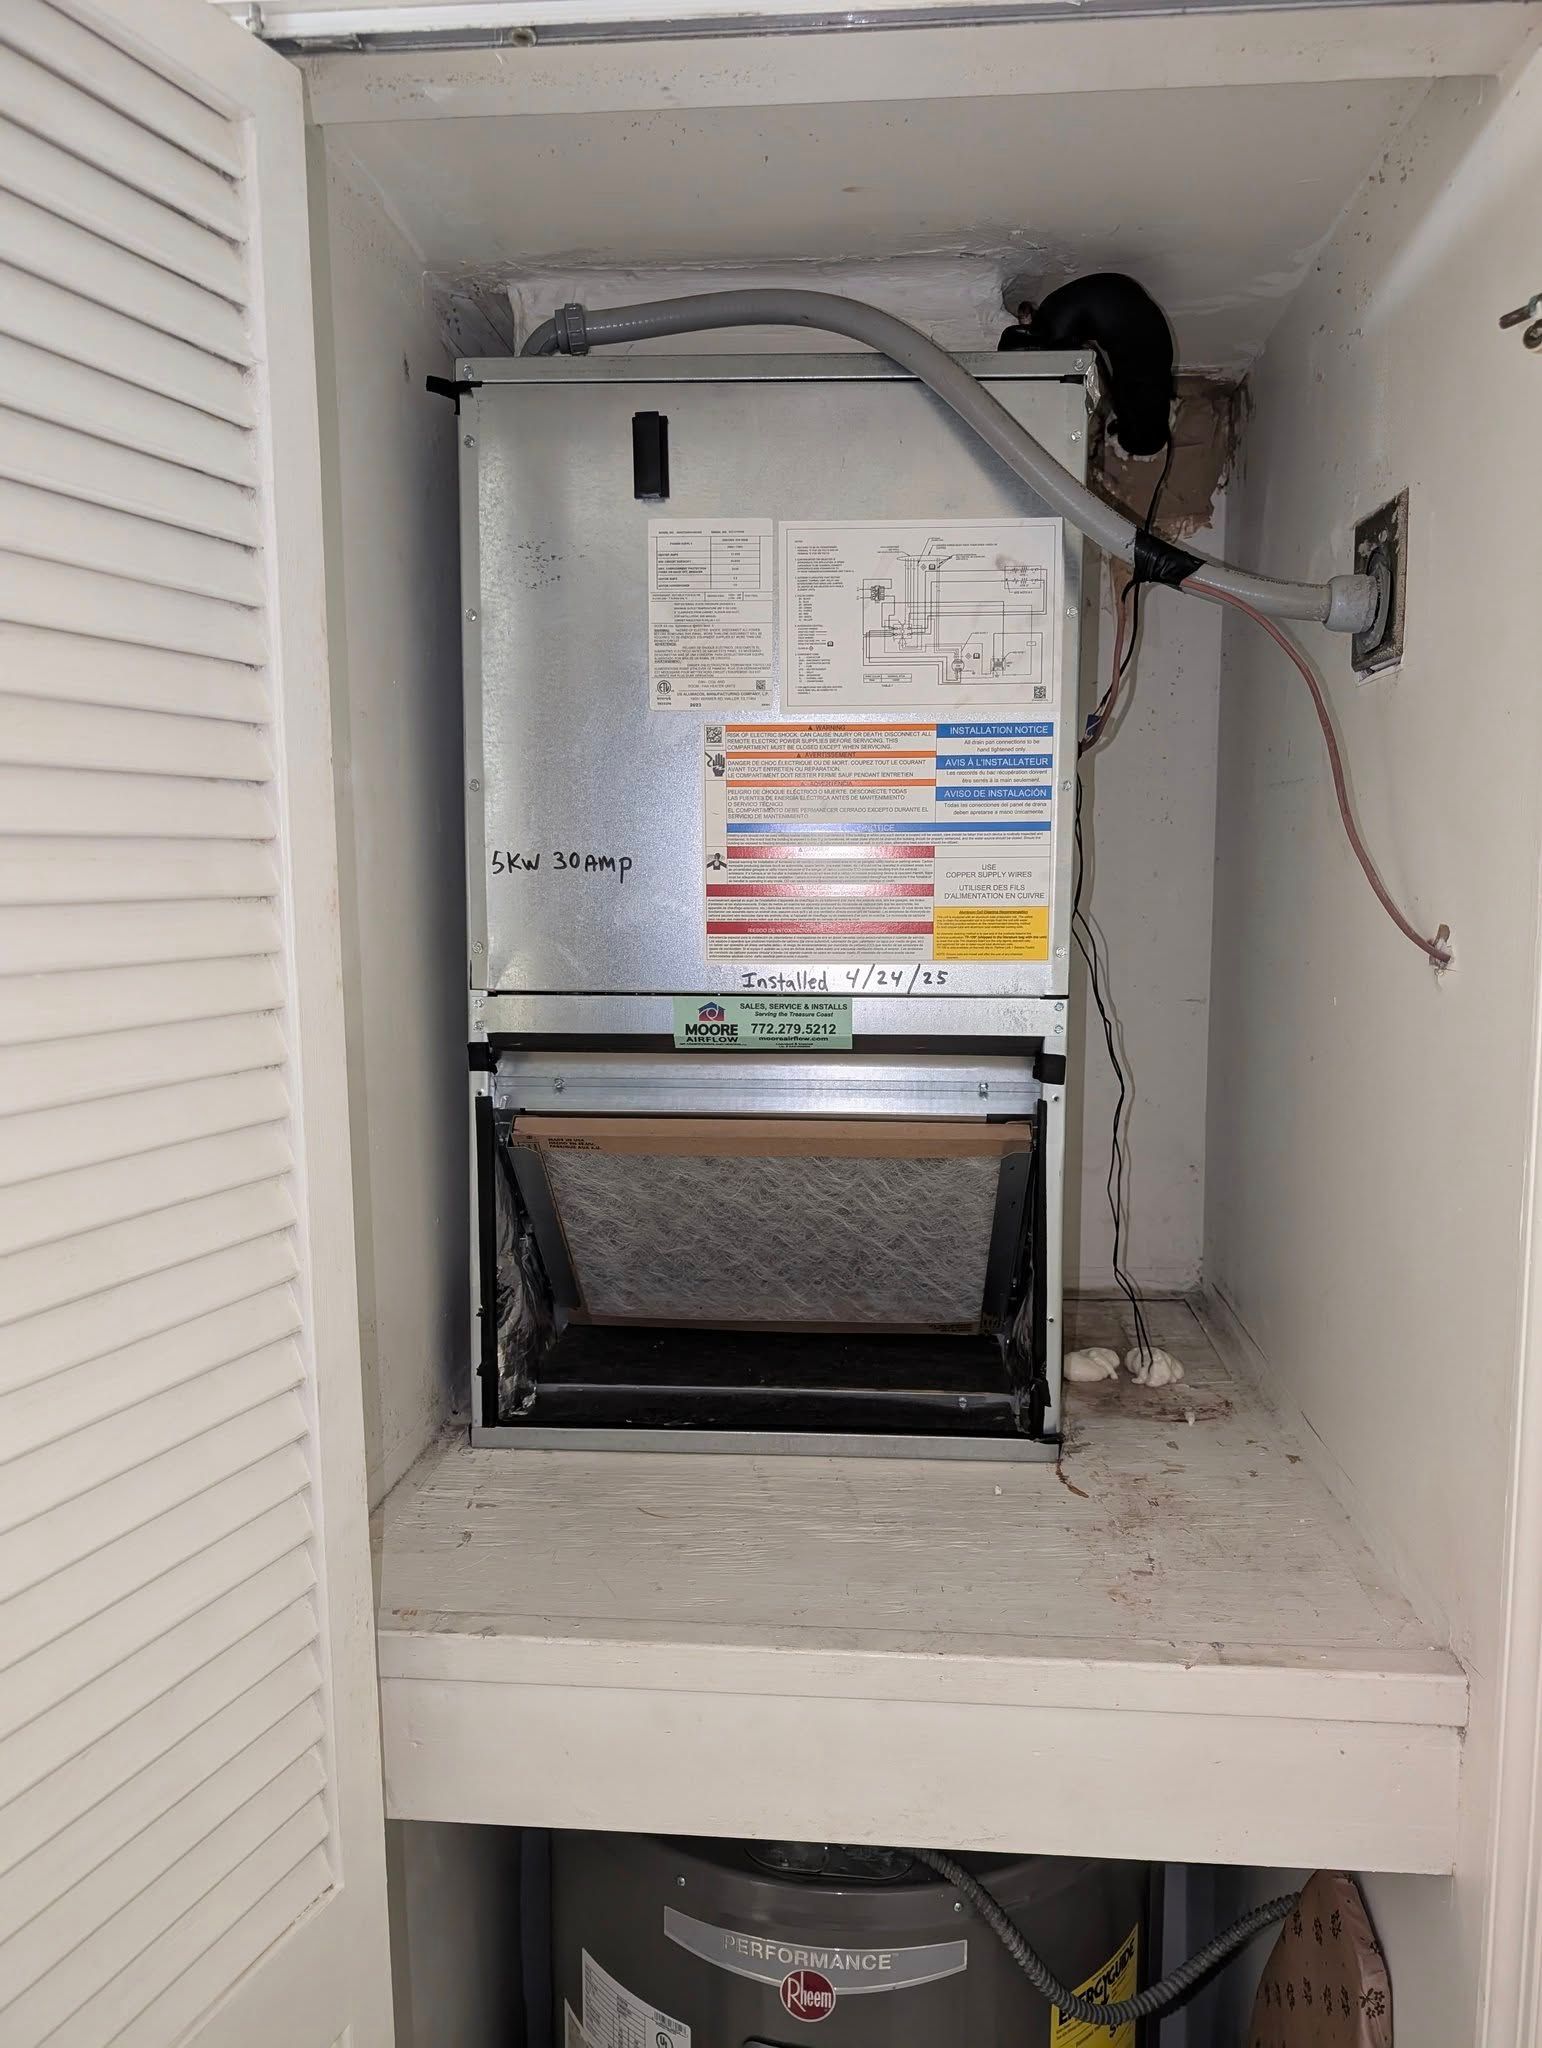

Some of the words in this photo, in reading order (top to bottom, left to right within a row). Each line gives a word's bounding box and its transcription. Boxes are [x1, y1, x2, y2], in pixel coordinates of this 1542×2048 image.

[968, 757, 974, 766] À
[976, 758, 1048, 766] L'INSTALLATEUR
[988, 788, 1046, 797] INSTALACIÓN
[741, 972, 828, 992] Installed
[846, 963, 948, 994] 4/24/25
[685, 1024, 738, 1036] MOORE
[751, 1023, 836, 1034] 772.279.5212
[723, 1935, 891, 1970] PERFORMANCE
[787, 1972, 831, 2012] Rheem
